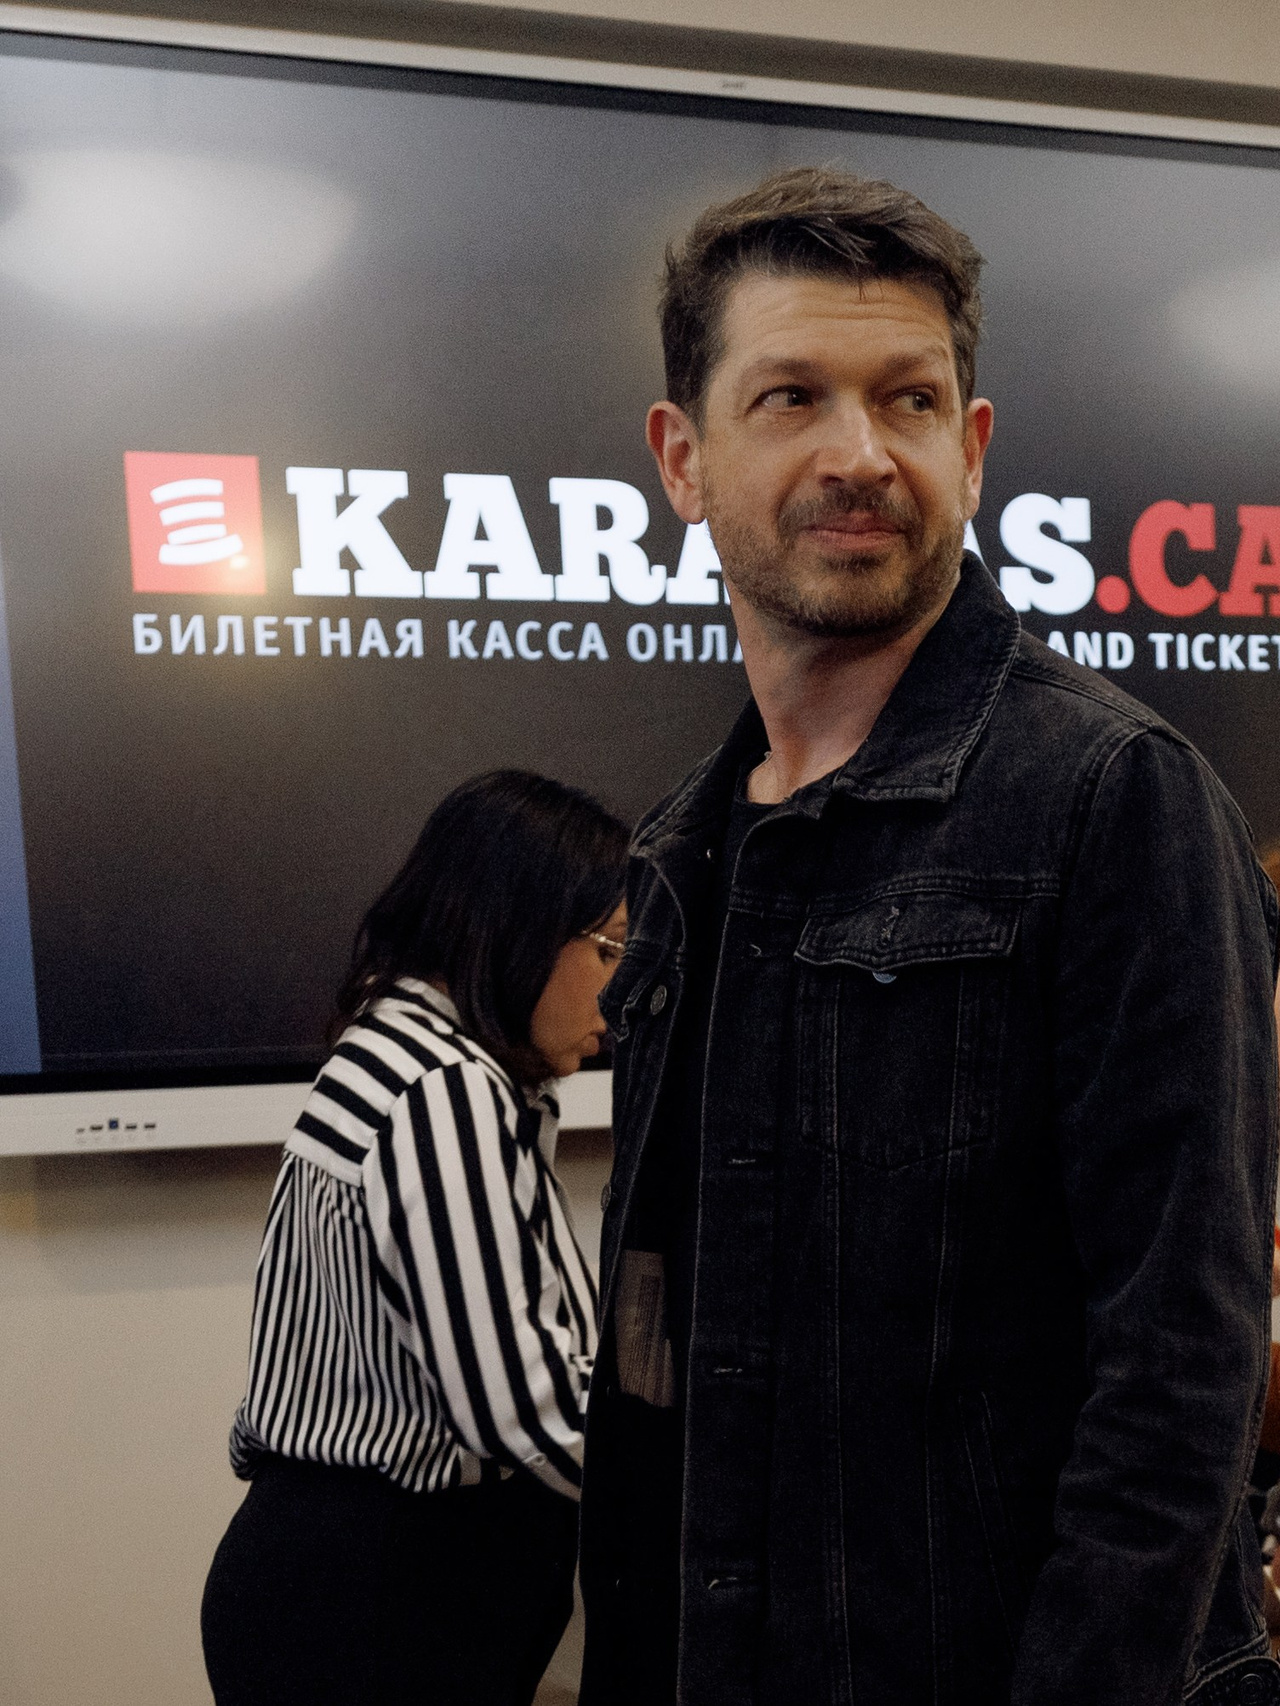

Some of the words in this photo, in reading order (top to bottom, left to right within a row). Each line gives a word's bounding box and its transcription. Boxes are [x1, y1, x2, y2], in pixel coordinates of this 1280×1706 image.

[132, 612, 425, 659] БИЛЕТНАЯ
[447, 619, 610, 662] КАССА
[626, 622, 745, 663] ОНЛ
